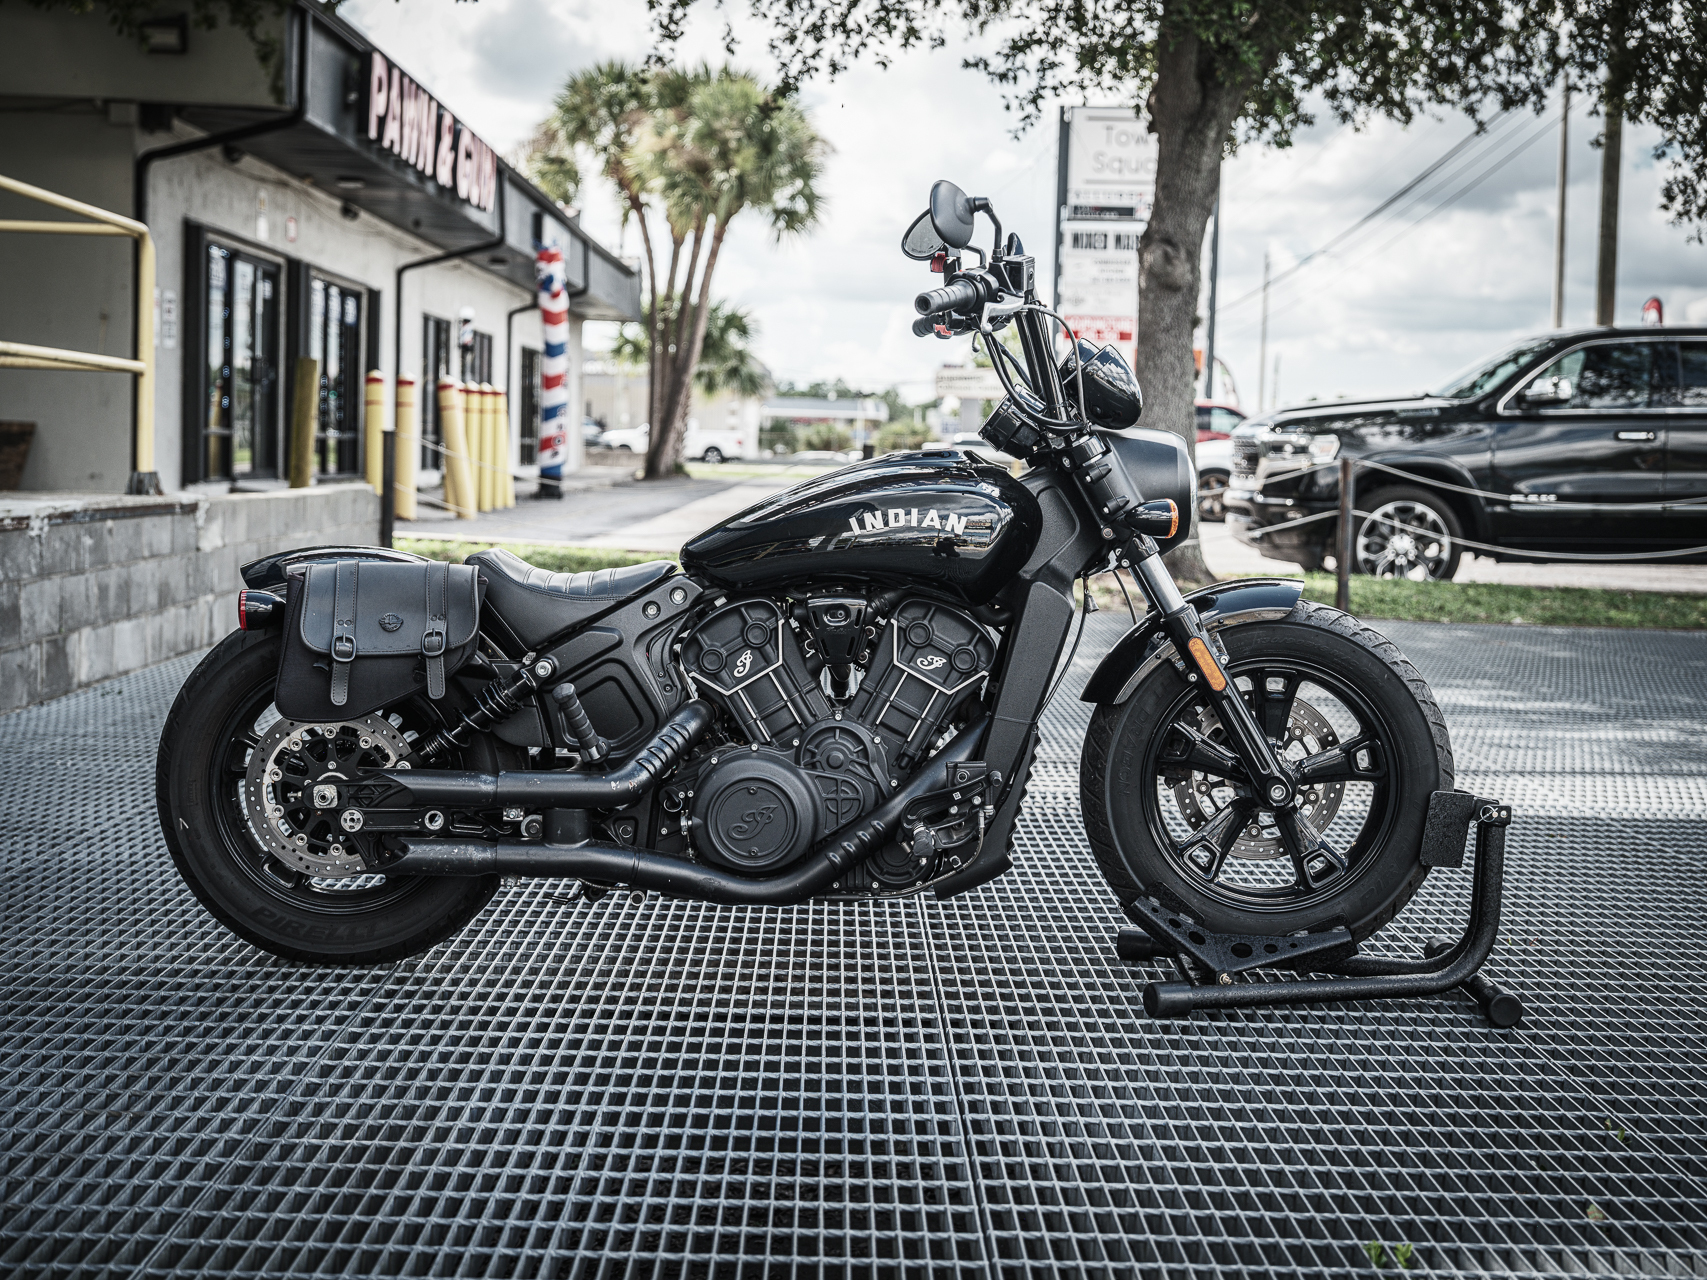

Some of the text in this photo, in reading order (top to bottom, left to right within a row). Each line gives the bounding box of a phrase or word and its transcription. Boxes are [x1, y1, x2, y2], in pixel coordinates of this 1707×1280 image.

[368, 51, 438, 177] PAWN
[436, 110, 456, 188] &
[848, 507, 968, 536] INDIAN
[251, 904, 379, 941] PIRELLI
